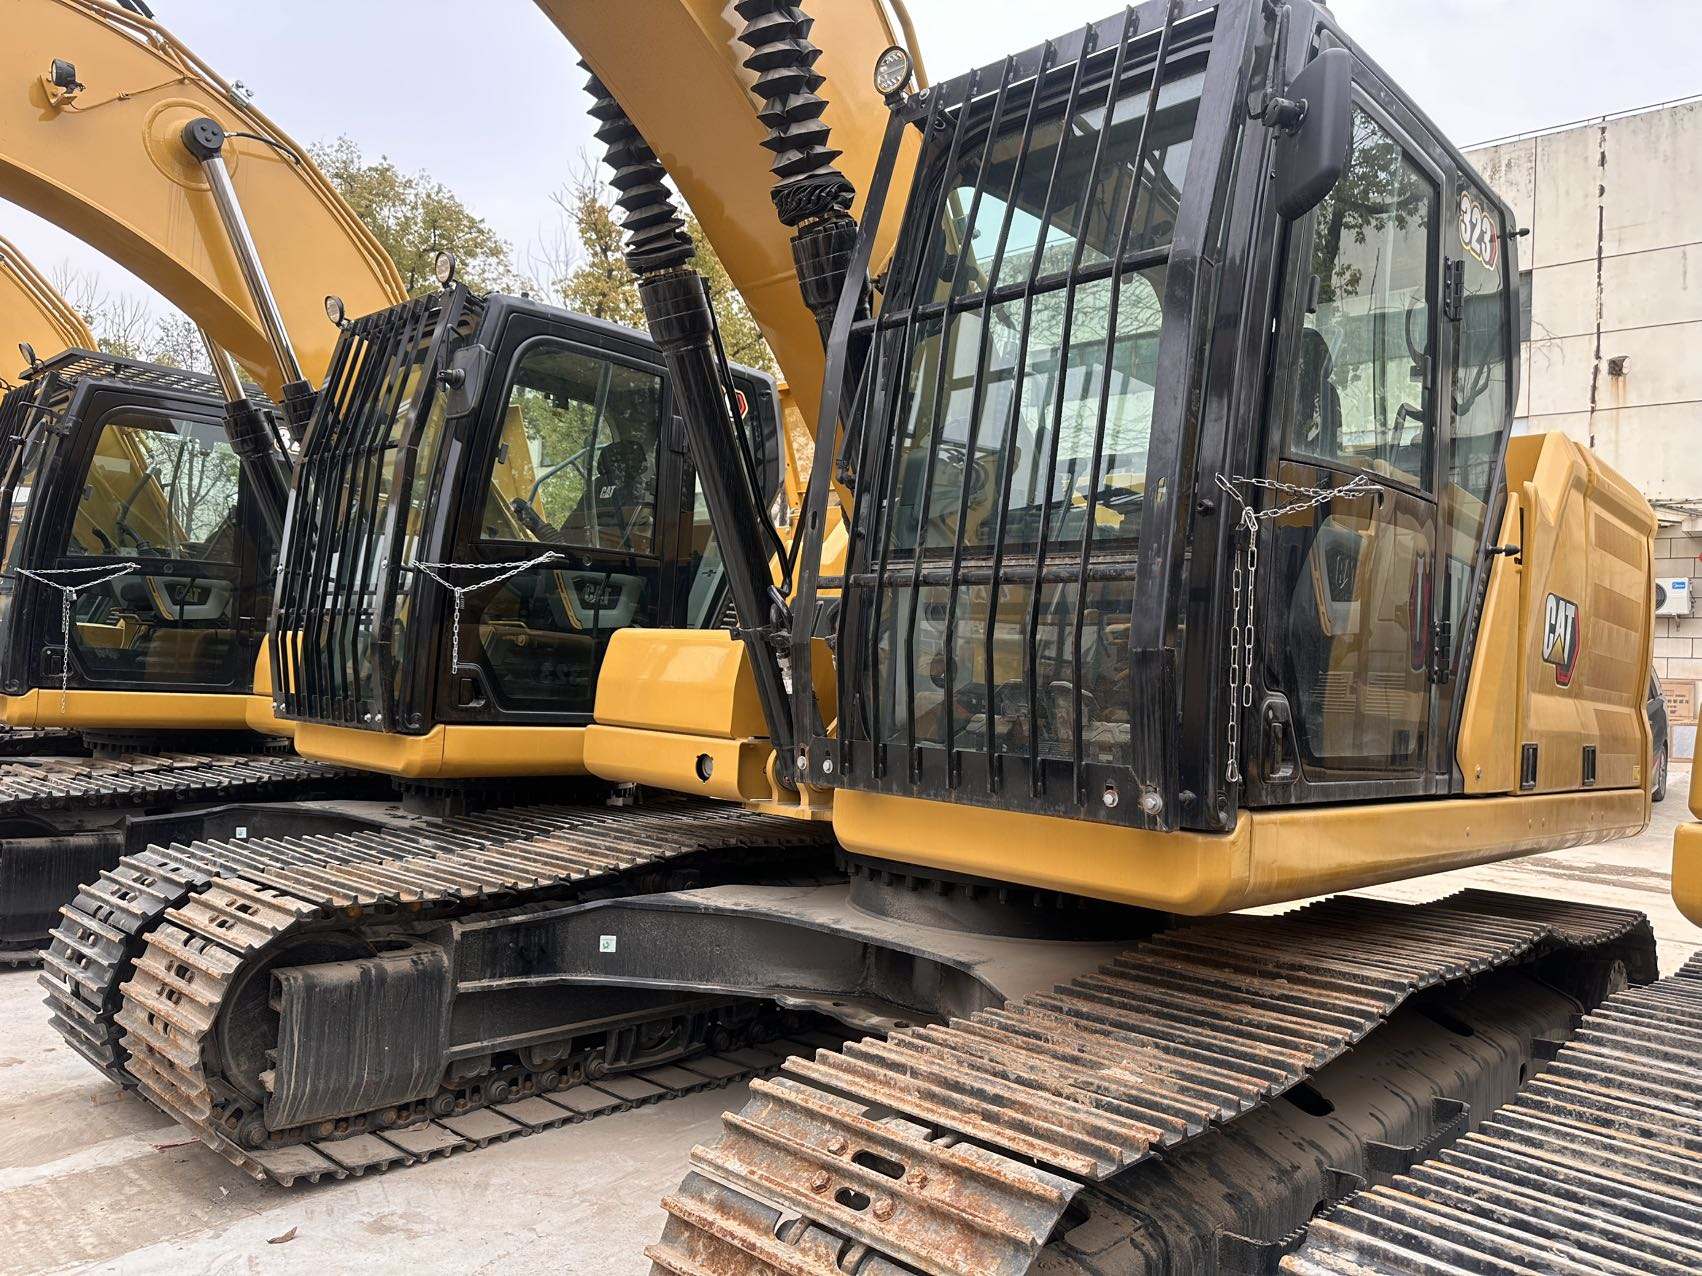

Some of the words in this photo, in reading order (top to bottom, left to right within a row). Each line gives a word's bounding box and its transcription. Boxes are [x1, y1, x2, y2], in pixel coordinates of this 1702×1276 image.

[1460, 196, 1491, 261] 323
[600, 485, 616, 498] CAT
[1542, 594, 1576, 665] CAT
